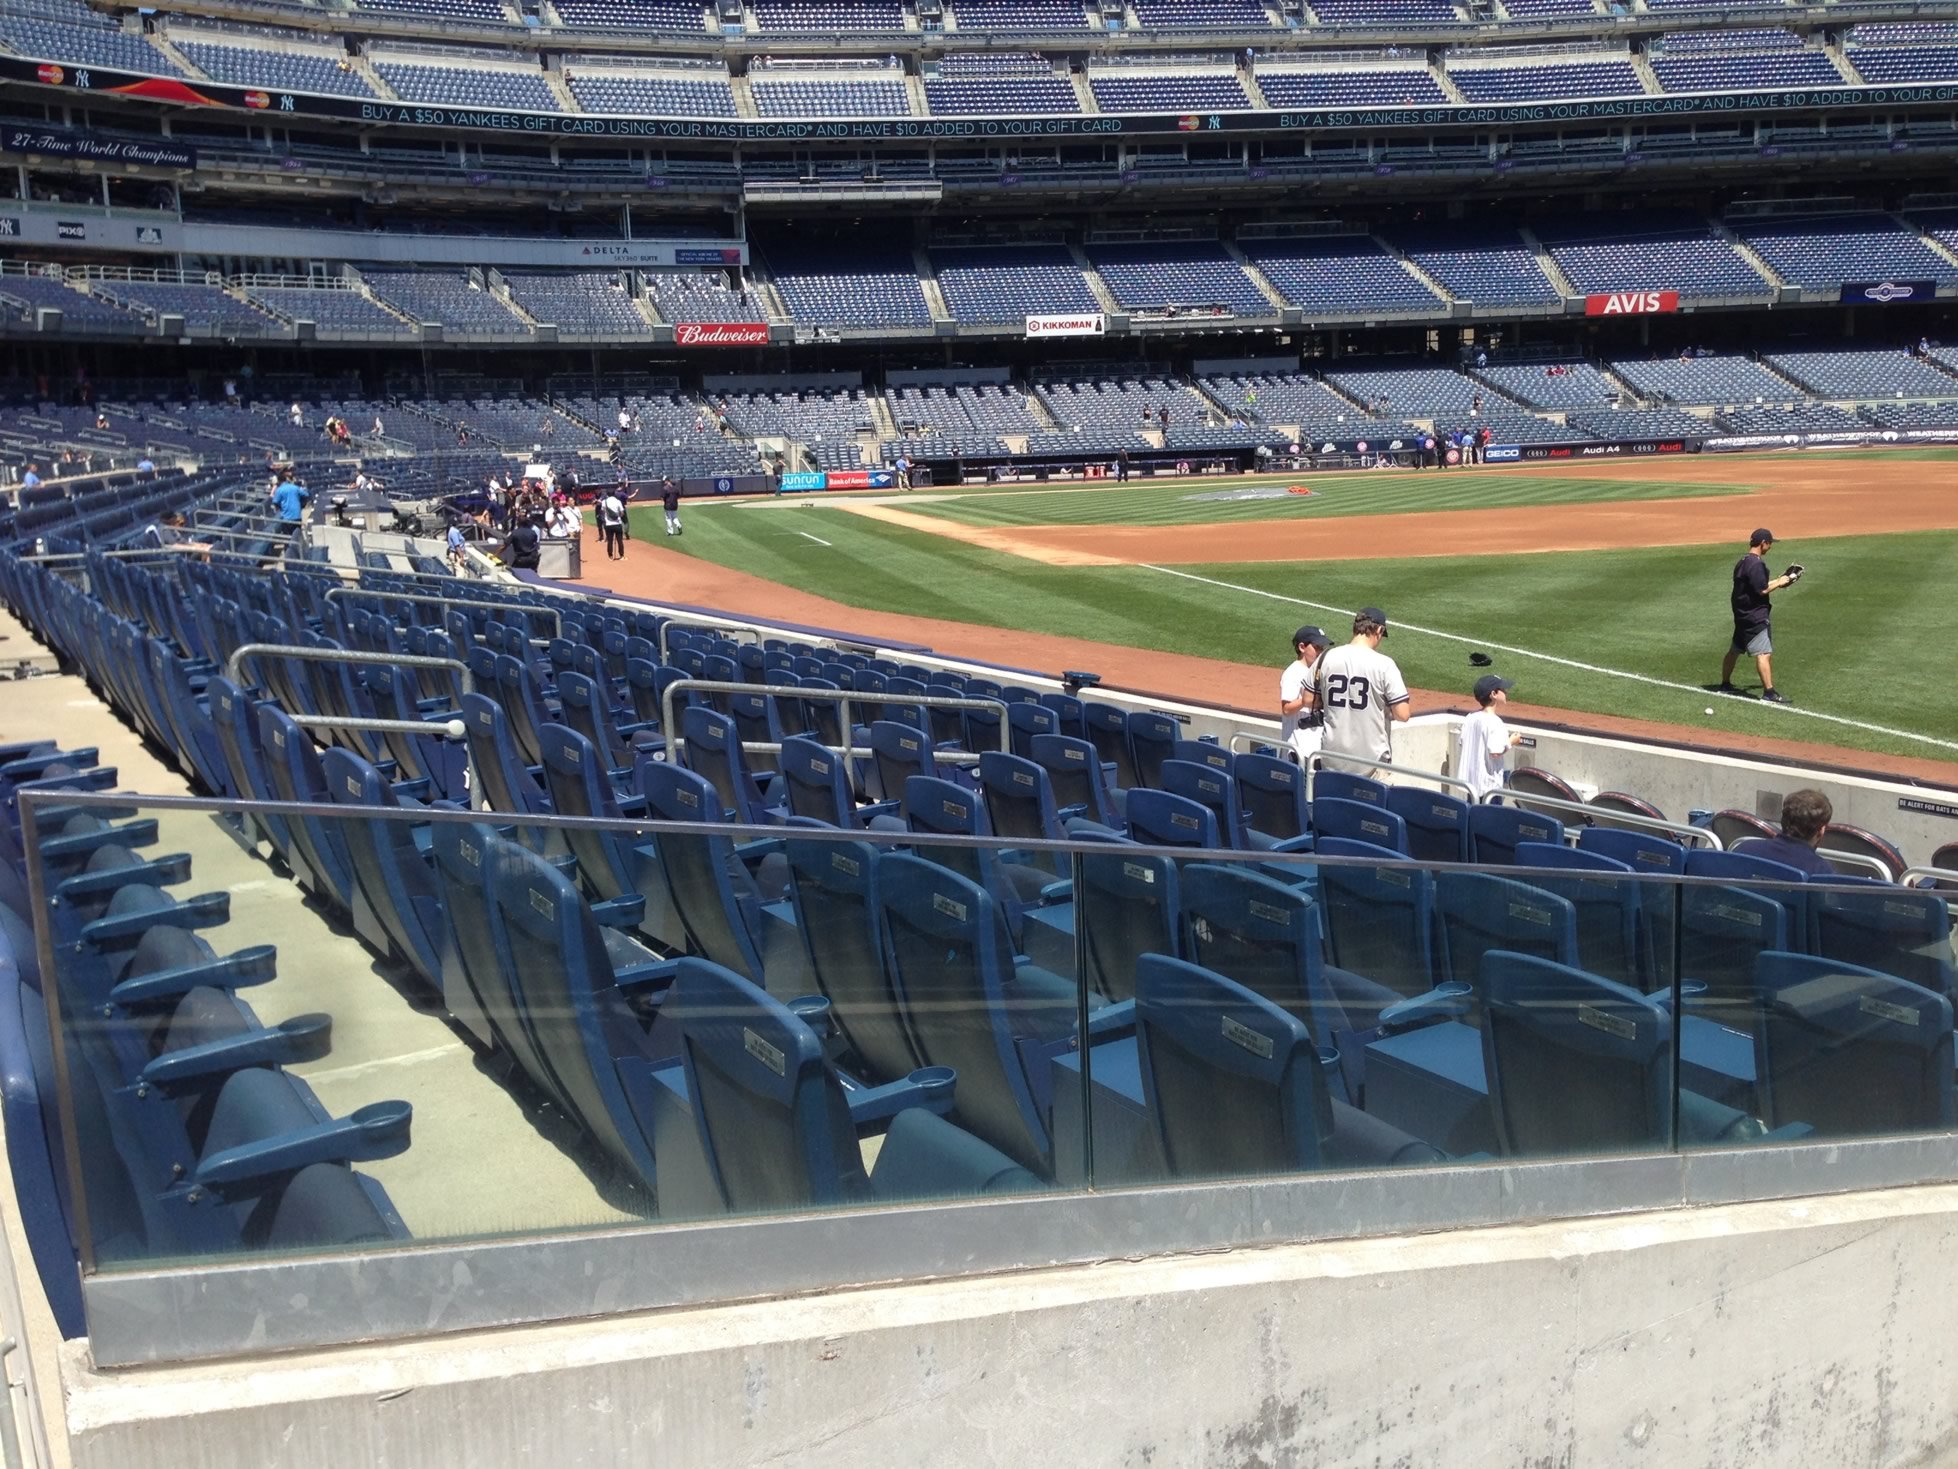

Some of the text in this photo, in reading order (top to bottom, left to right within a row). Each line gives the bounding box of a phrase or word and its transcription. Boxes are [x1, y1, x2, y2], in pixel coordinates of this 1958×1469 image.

[1280, 114, 1309, 127] BUY
[1312, 113, 1323, 126] A
[1327, 112, 1352, 126] $50
[1357, 111, 1419, 125] YANKEES
[1423, 109, 1454, 123] GIFT
[1458, 109, 1497, 122] CARD
[1500, 107, 1544, 121] USING
[1549, 104, 1589, 118] YOUR
[1703, 96, 1735, 110] AND
[1739, 94, 1779, 107] HAVE
[1783, 93, 1806, 107] $10
[1810, 91, 1862, 105] ADDED
[1867, 89, 1886, 102] TO
[1891, 88, 1932, 101] YOUR
[362, 104, 393, 120] BUY
[398, 108, 410, 122] A
[415, 108, 444, 124] $50
[449, 111, 520, 130] YANKEES
[523, 116, 557, 131] GIFT
[561, 119, 605, 134] CARD
[609, 120, 656, 135] USING
[660, 122, 701, 136] YOUR
[816, 123, 848, 137] AND
[853, 123, 891, 136] HAVE
[895, 122, 919, 136] $10
[922, 121, 975, 136] ADDED
[979, 121, 998, 134] TO
[1002, 120, 1042, 134] YOUR
[1046, 120, 1077, 133] GIFT
[1081, 119, 1122, 132] CARD
[11, 132, 189, 164] 27-Time World Champions
[594, 246, 629, 254] DELTA
[1603, 292, 1661, 314] AVIS
[1042, 320, 1092, 330] KIKKOMAN
[677, 325, 767, 345] Budweiser
[1583, 445, 1620, 455] Audi A4
[1659, 442, 1682, 451] Audi
[1486, 449, 1519, 458] GEICO
[1550, 449, 1570, 457] Audi
[829, 478, 844, 486] Bank
[851, 477, 876, 485] America
[1328, 673, 1369, 710] 23
